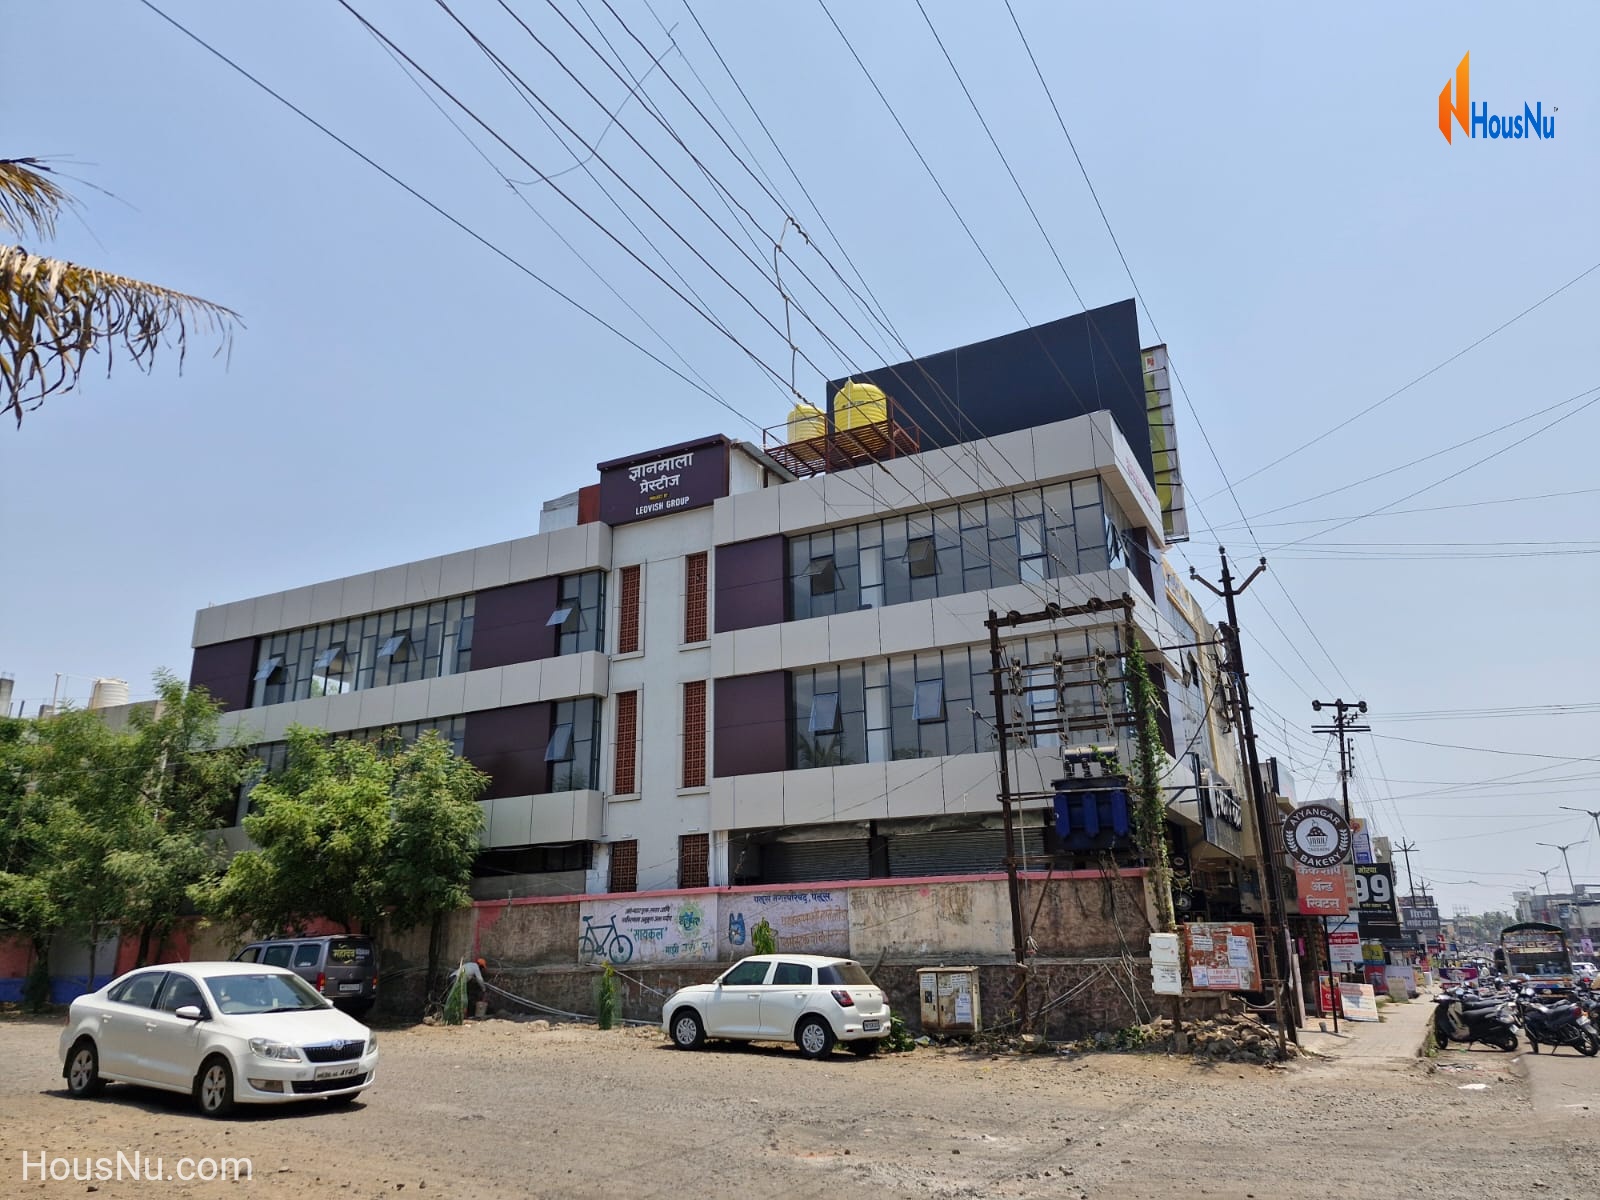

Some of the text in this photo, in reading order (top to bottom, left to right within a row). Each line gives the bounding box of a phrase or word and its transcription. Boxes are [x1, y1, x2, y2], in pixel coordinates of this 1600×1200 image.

[628, 452, 695, 482] ज्ञानमाला
[639, 473, 681, 494] प्रेस्टीज
[635, 496, 690, 516] LEOVISH GROUP
[1290, 808, 1341, 827] AYYANGAR
[1300, 852, 1342, 867] BAKERY
